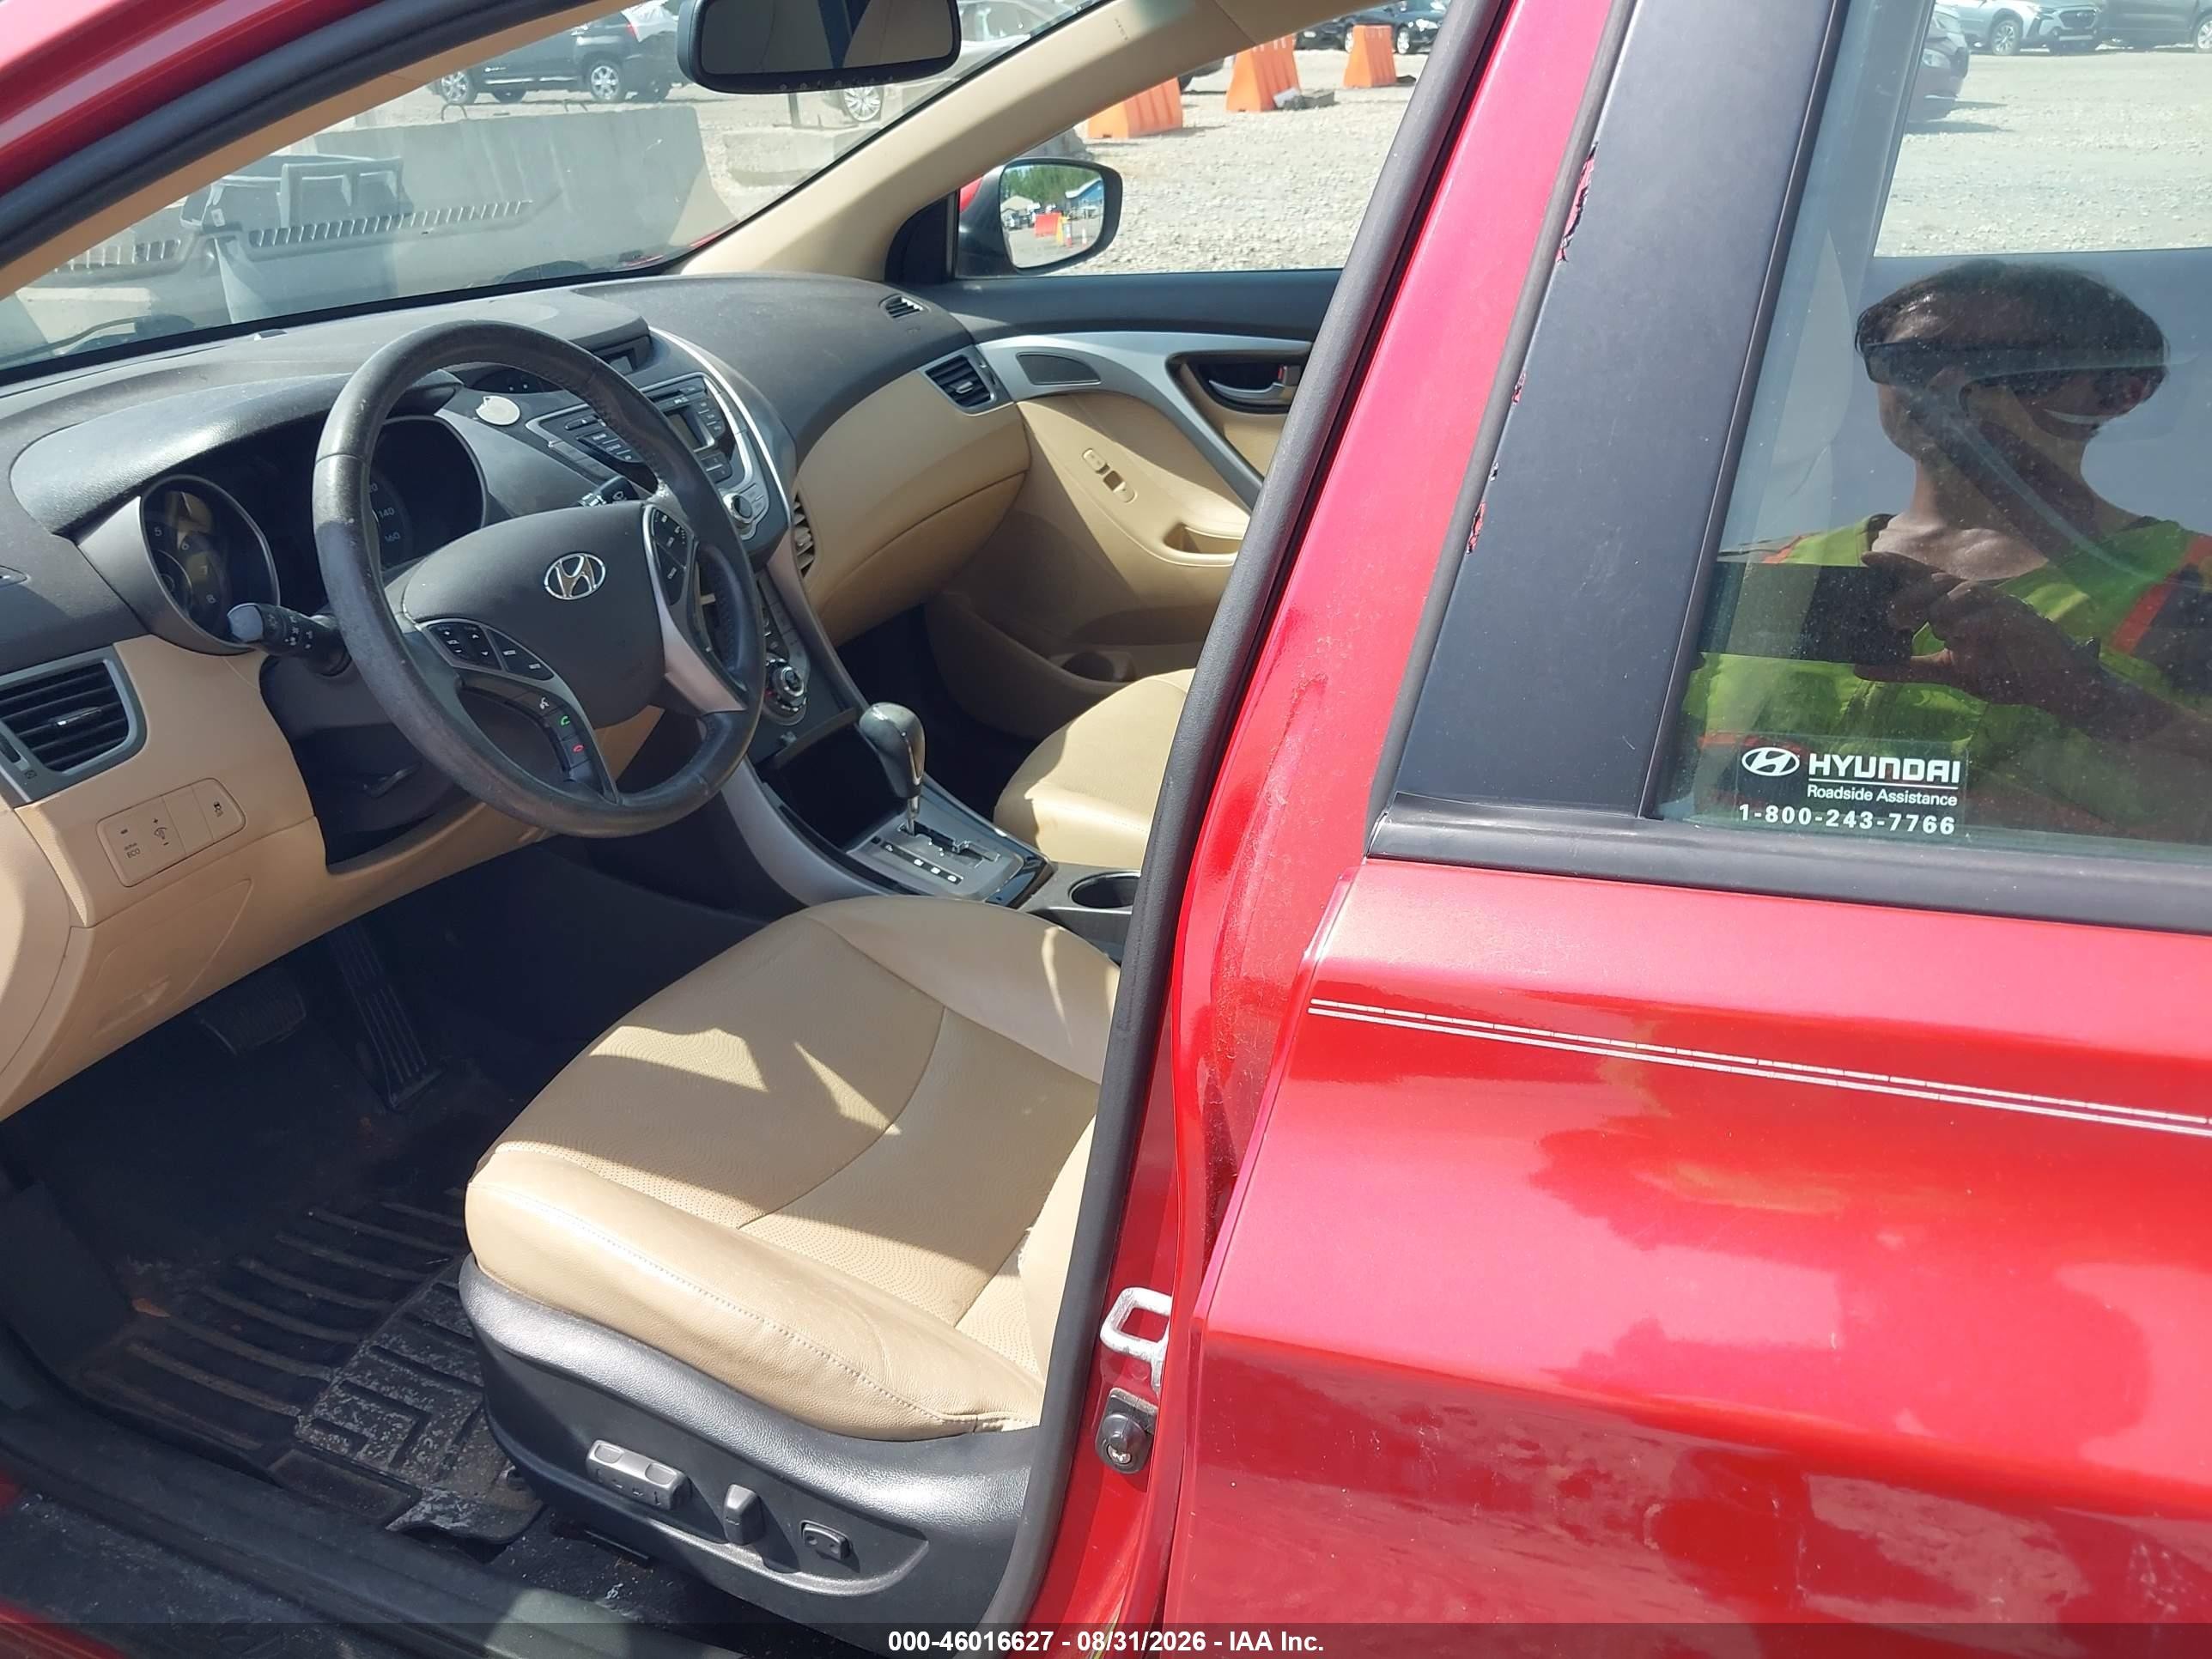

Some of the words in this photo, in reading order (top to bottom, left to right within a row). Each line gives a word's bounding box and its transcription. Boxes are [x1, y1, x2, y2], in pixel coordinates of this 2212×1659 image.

[154, 526, 162, 537] 5
[1808, 753, 1961, 783] HYUNDAI
[1807, 784, 1873, 801] Roadside
[1876, 788, 1958, 806] Assistance
[1739, 804, 1955, 835] 1-800-243-7766
[127, 848, 140, 858] ECO
